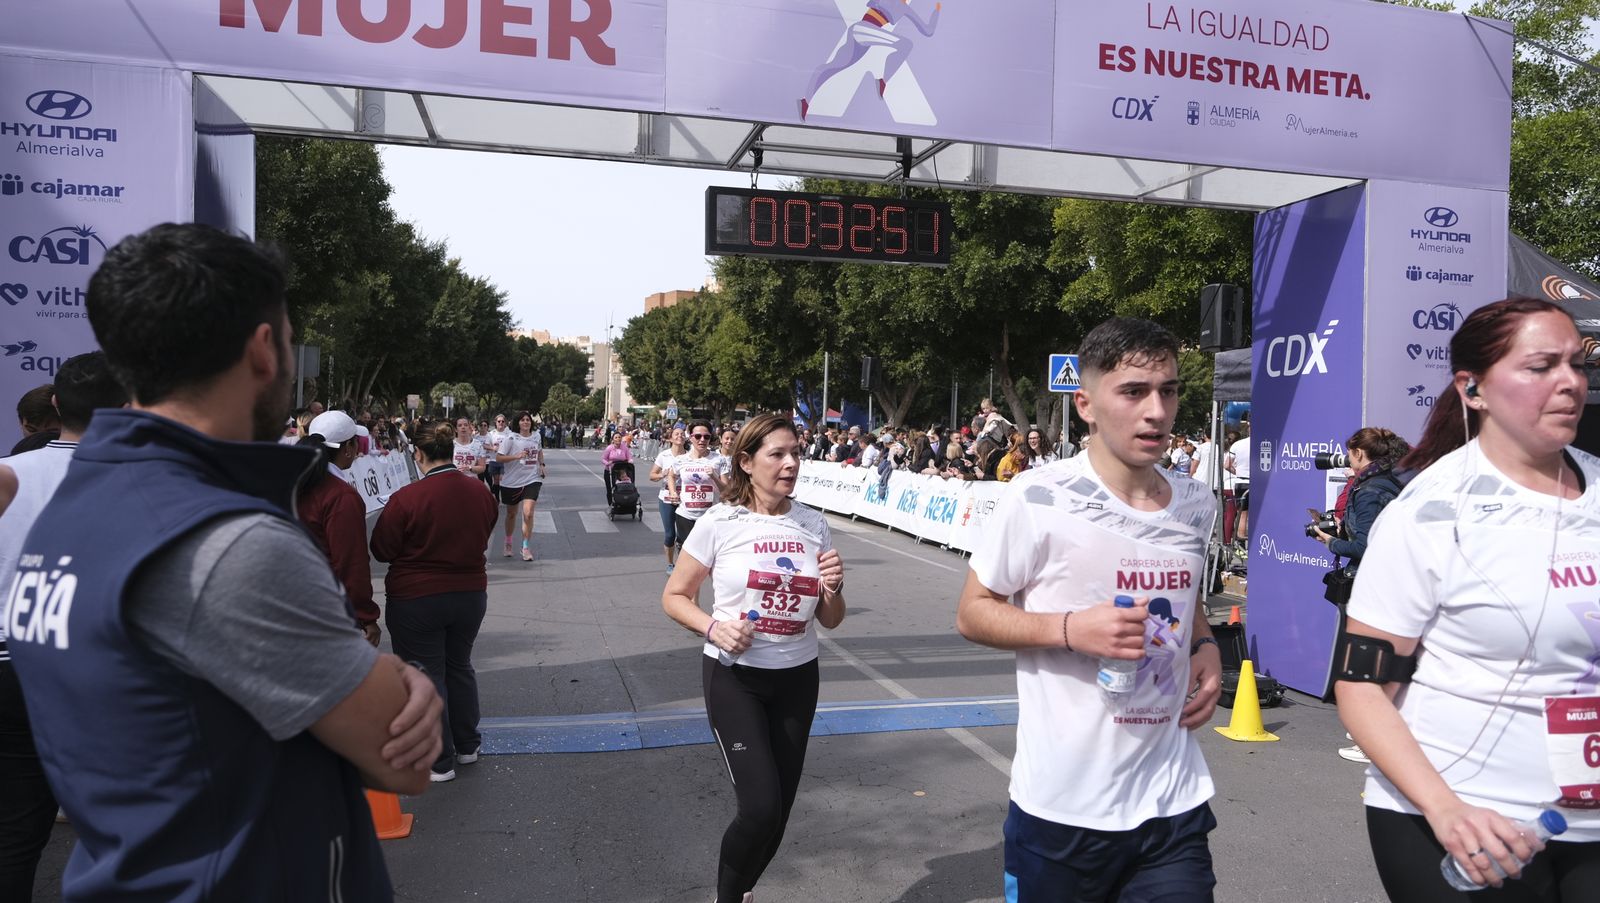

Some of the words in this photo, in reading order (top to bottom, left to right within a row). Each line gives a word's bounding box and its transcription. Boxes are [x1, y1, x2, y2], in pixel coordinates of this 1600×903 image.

[1147, 3, 1182, 32] LA
[1190, 8, 1330, 51] IGUALDAD
[1099, 43, 1136, 72] ES
[1144, 48, 1281, 91] NUESTRA
[1286, 66, 1371, 101] META.
[1112, 96, 1159, 121] CDX
[1210, 104, 1261, 121] ALMERÍA
[1, 121, 118, 142] HYUNDAI
[1209, 117, 1236, 128] CIUDAD
[16, 141, 105, 158] Almerialva
[30, 178, 125, 199] cajamar
[751, 197, 939, 254] 00:32:51
[1411, 229, 1471, 243] HYUNDAI
[8, 235, 90, 265] CASI
[1418, 242, 1465, 254] Almerialva
[1425, 269, 1474, 284] cajamar
[36, 309, 57, 318] vivir
[59, 311, 80, 320] para
[1413, 309, 1455, 331] CASI
[1266, 320, 1340, 378] CDX
[1281, 439, 1344, 458] ALMERÍA
[1281, 460, 1311, 471] CIUDAD
[923, 495, 958, 525] NEXA
[754, 541, 806, 554] MUJER
[1120, 558, 1162, 568] CARRERA
[1163, 559, 1175, 569] DE
[1177, 558, 1188, 567] LA
[1116, 570, 1192, 590] MUJER
[1547, 565, 1600, 588] MU
[760, 592, 802, 612] 532
[767, 609, 792, 617] RAFAELA
[1123, 717, 1158, 725] NUESTRA
[1566, 711, 1598, 721] MUJER
